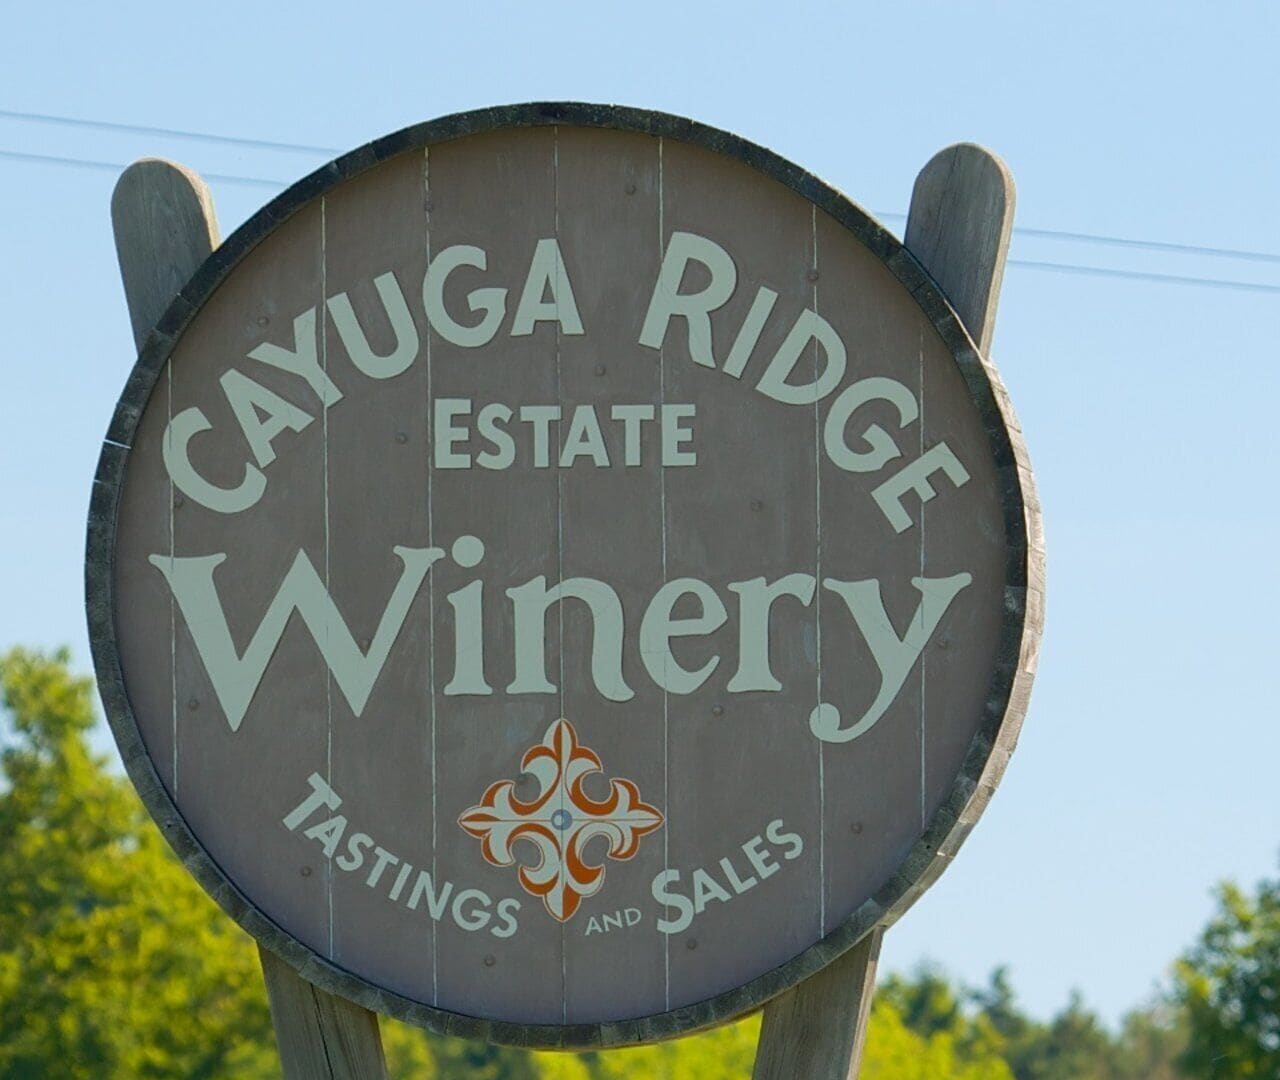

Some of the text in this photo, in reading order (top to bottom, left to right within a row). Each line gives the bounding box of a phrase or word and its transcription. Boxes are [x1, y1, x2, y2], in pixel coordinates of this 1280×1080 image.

[162, 231, 971, 533] CAYUGA RIDGE
[434, 398, 697, 469] ESTATE
[149, 535, 973, 743] Winery
[283, 772, 804, 939] TASTINGS AND SALES
